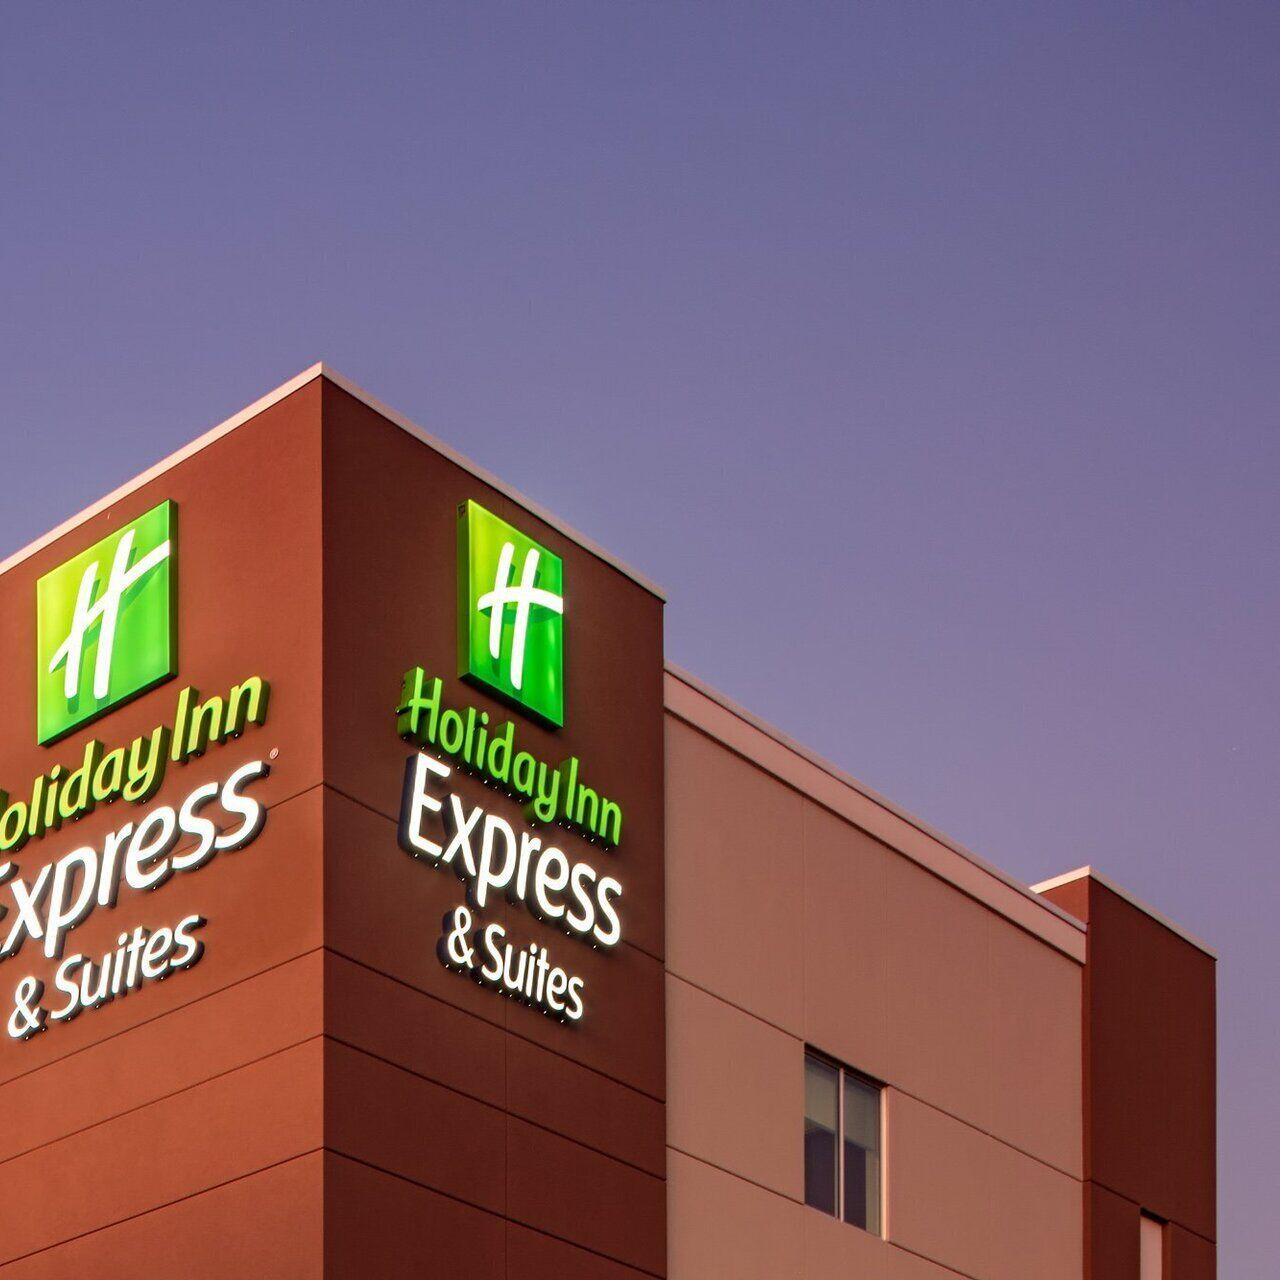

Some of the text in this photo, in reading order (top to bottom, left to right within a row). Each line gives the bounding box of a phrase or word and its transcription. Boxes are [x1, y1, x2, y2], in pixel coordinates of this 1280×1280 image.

[49, 528, 171, 701] H
[477, 541, 564, 691] H
[171, 675, 266, 763] Inn
[406, 666, 622, 846] Holiday Inn
[406, 752, 622, 947] Express
[8, 915, 203, 1039] & Suites
[446, 905, 584, 1021] & Suites
